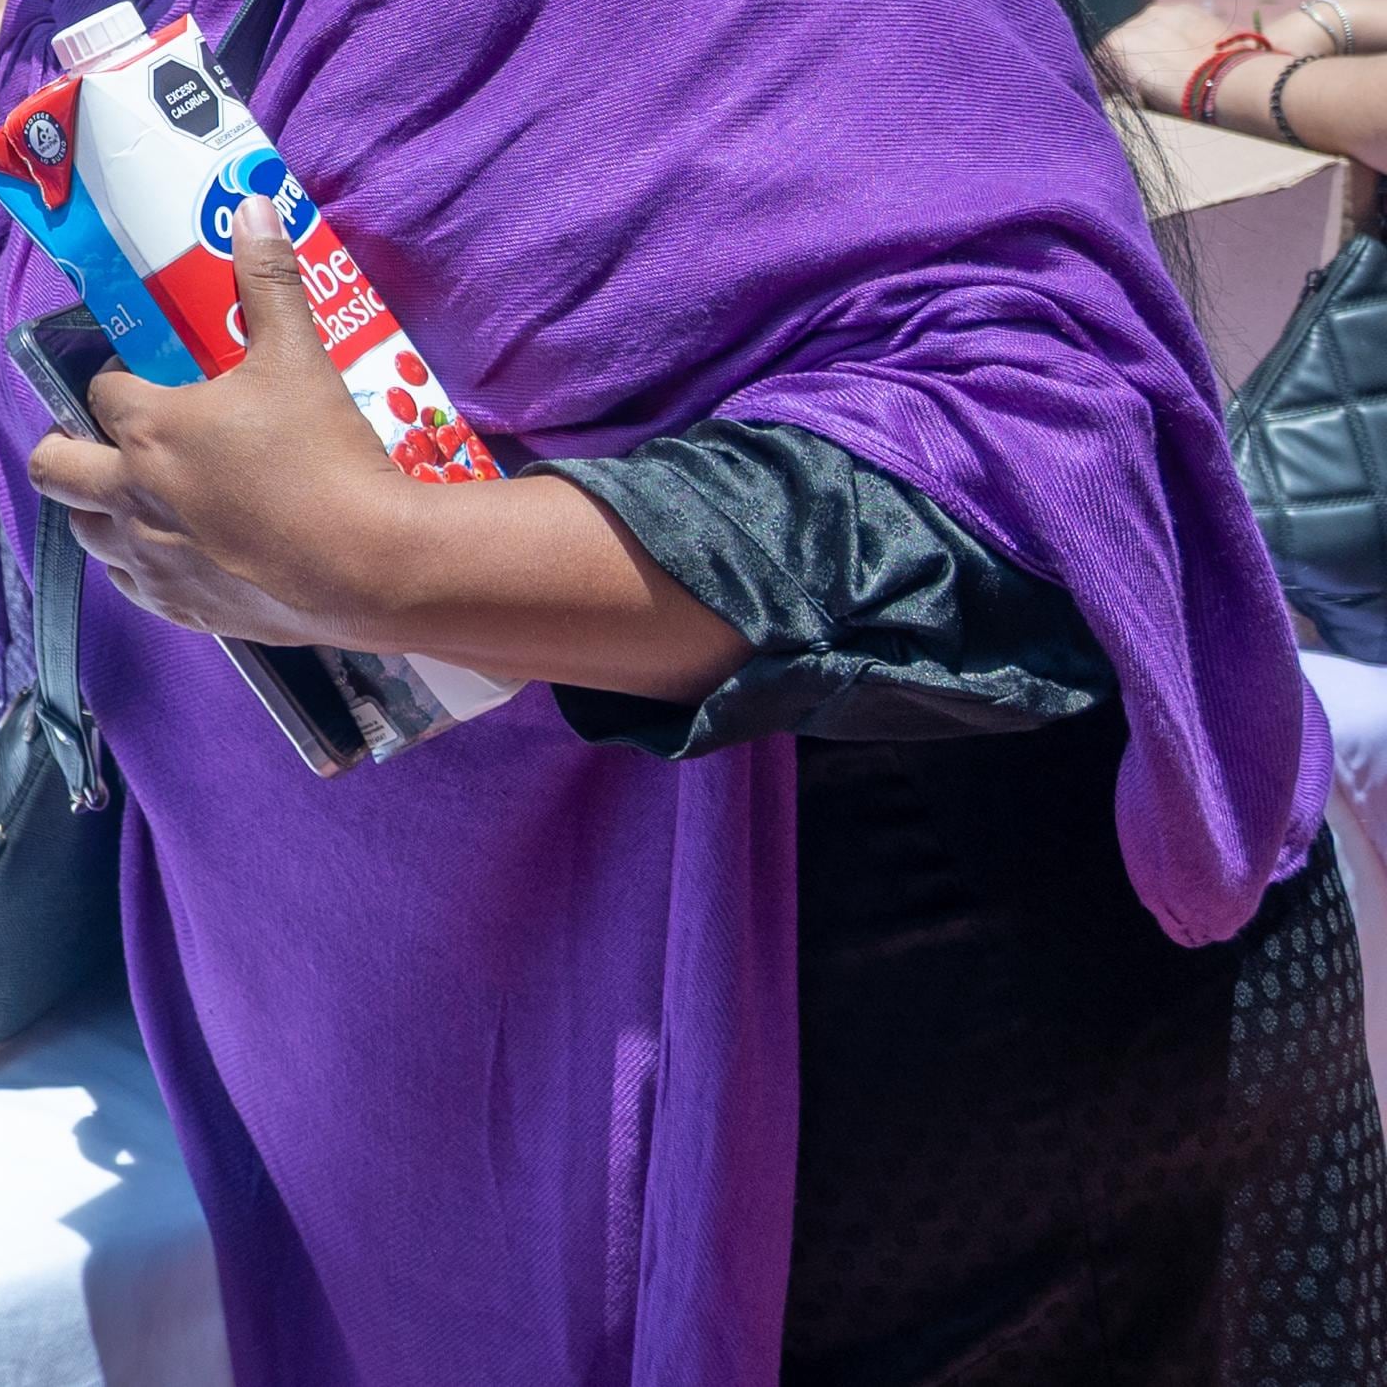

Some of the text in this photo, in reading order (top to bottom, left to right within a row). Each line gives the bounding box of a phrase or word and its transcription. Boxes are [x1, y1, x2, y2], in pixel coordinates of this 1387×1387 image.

[165, 80, 197, 105] EXCESO
[170, 90, 210, 120] CALORÍAS
[24, 112, 49, 135] PROTEGE
